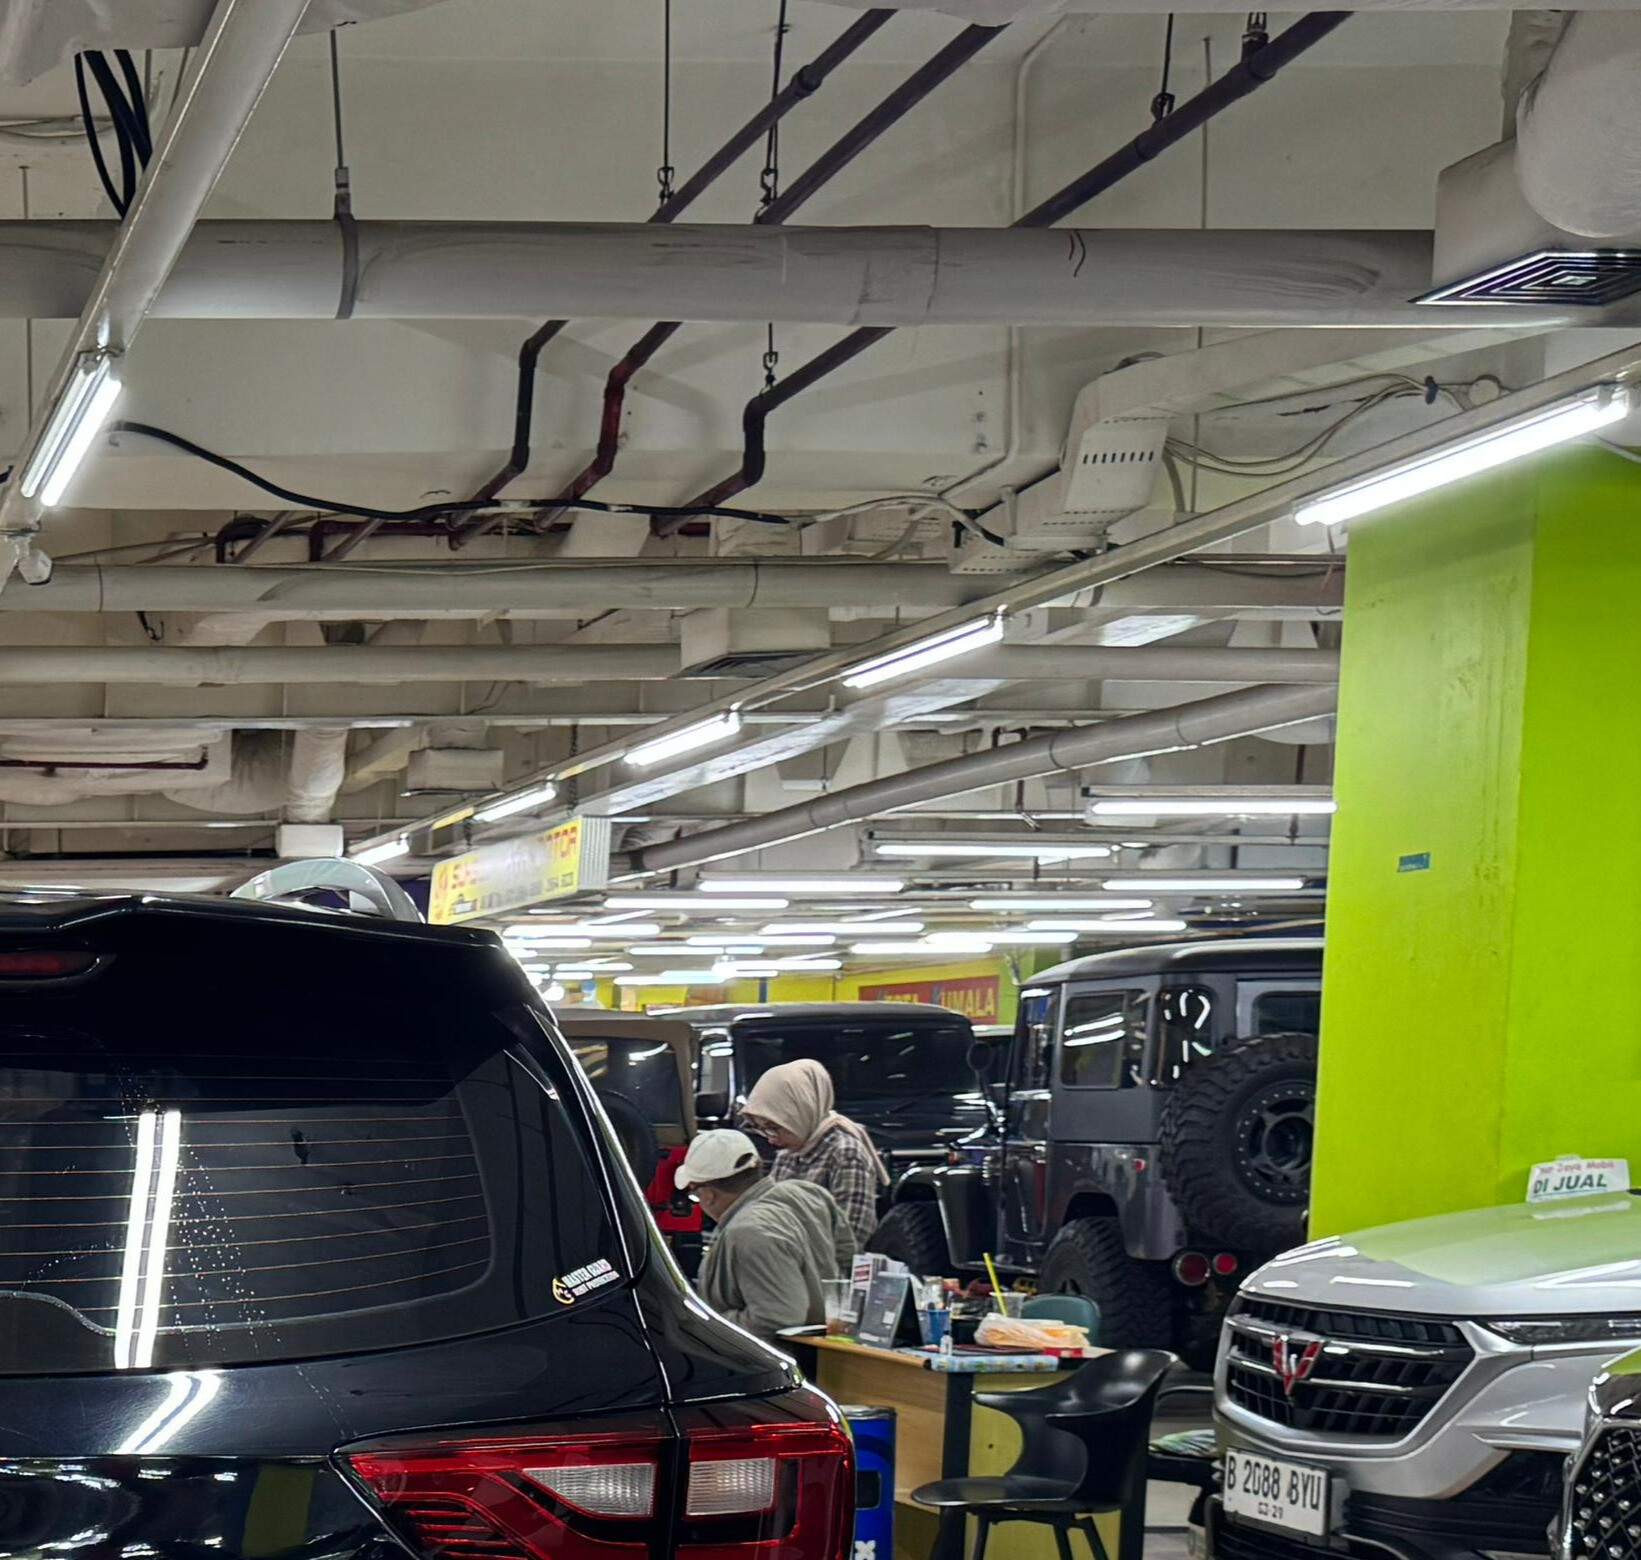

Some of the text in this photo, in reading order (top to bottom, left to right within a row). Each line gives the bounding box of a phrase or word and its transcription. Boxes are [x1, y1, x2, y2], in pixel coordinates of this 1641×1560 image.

[1553, 1173, 1608, 1192] JUAL
[1227, 1455, 1322, 1512] B 2088 BYU
